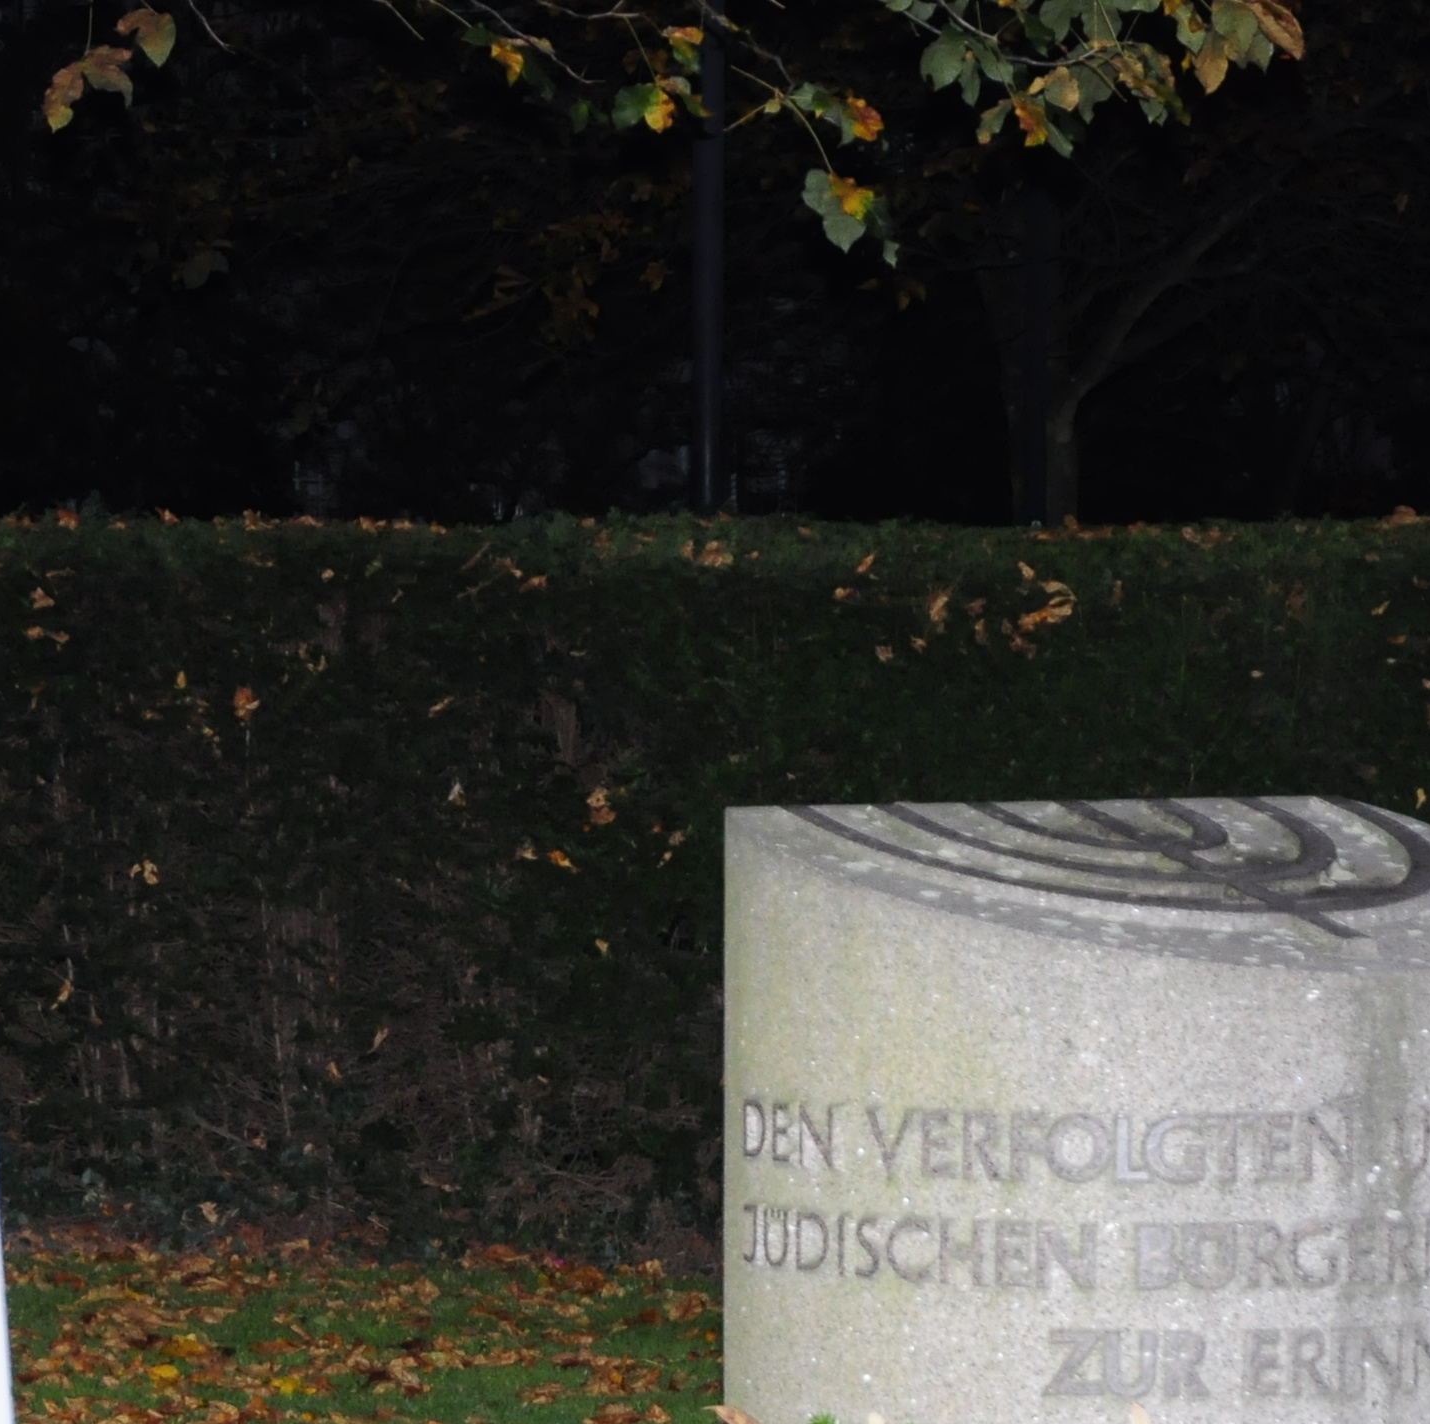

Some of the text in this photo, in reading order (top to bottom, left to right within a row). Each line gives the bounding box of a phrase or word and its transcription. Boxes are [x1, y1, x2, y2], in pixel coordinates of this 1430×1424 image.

[741, 1097, 844, 1171] DEN
[864, 1103, 1357, 1186] VERFOLGTEN
[742, 1202, 1100, 1290] JÜDISCHEN
[1040, 1326, 1211, 1401] ZUR
